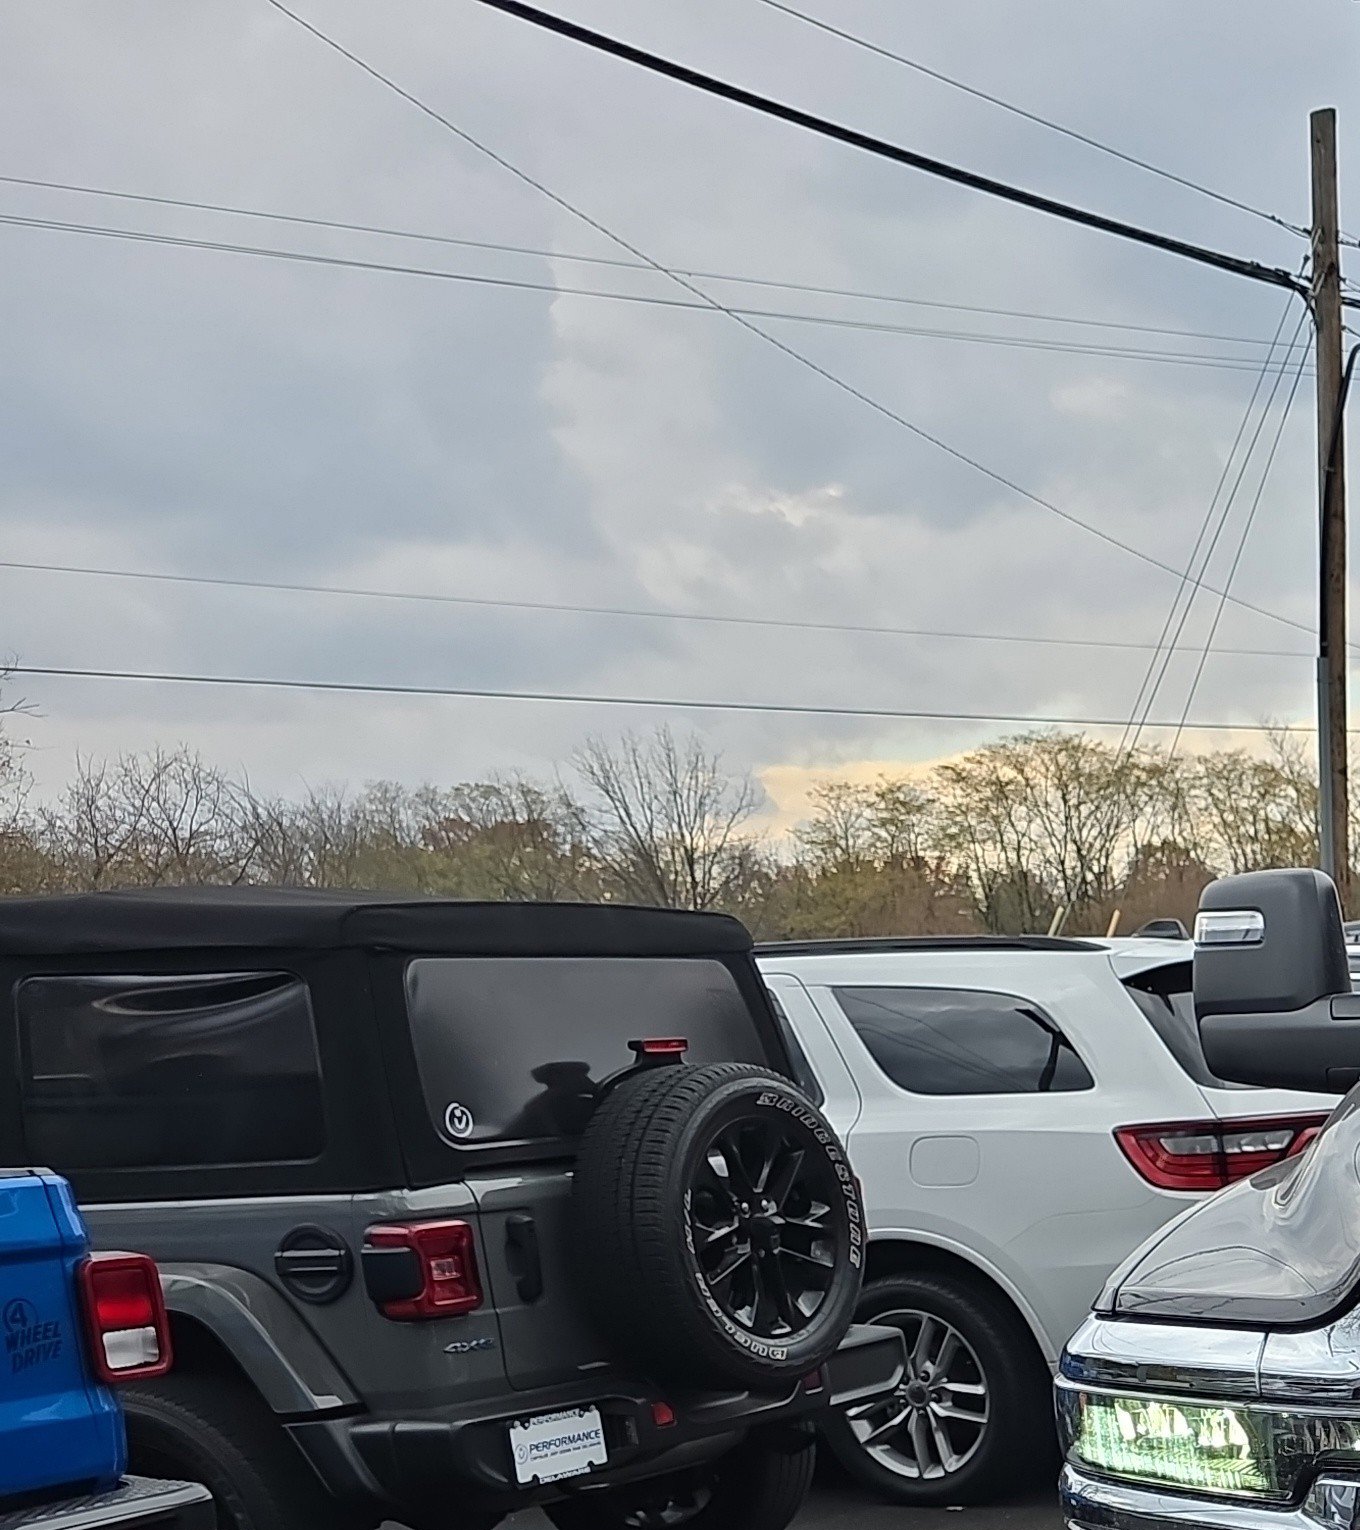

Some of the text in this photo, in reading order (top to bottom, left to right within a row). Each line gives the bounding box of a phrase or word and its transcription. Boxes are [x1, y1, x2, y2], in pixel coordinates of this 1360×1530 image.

[757, 1092, 861, 1268] BRIDGESTONE
[5, 1321, 61, 1353] WHEEL
[12, 1340, 62, 1373] DRIVE
[529, 1429, 601, 1454] PERFORMANCE
